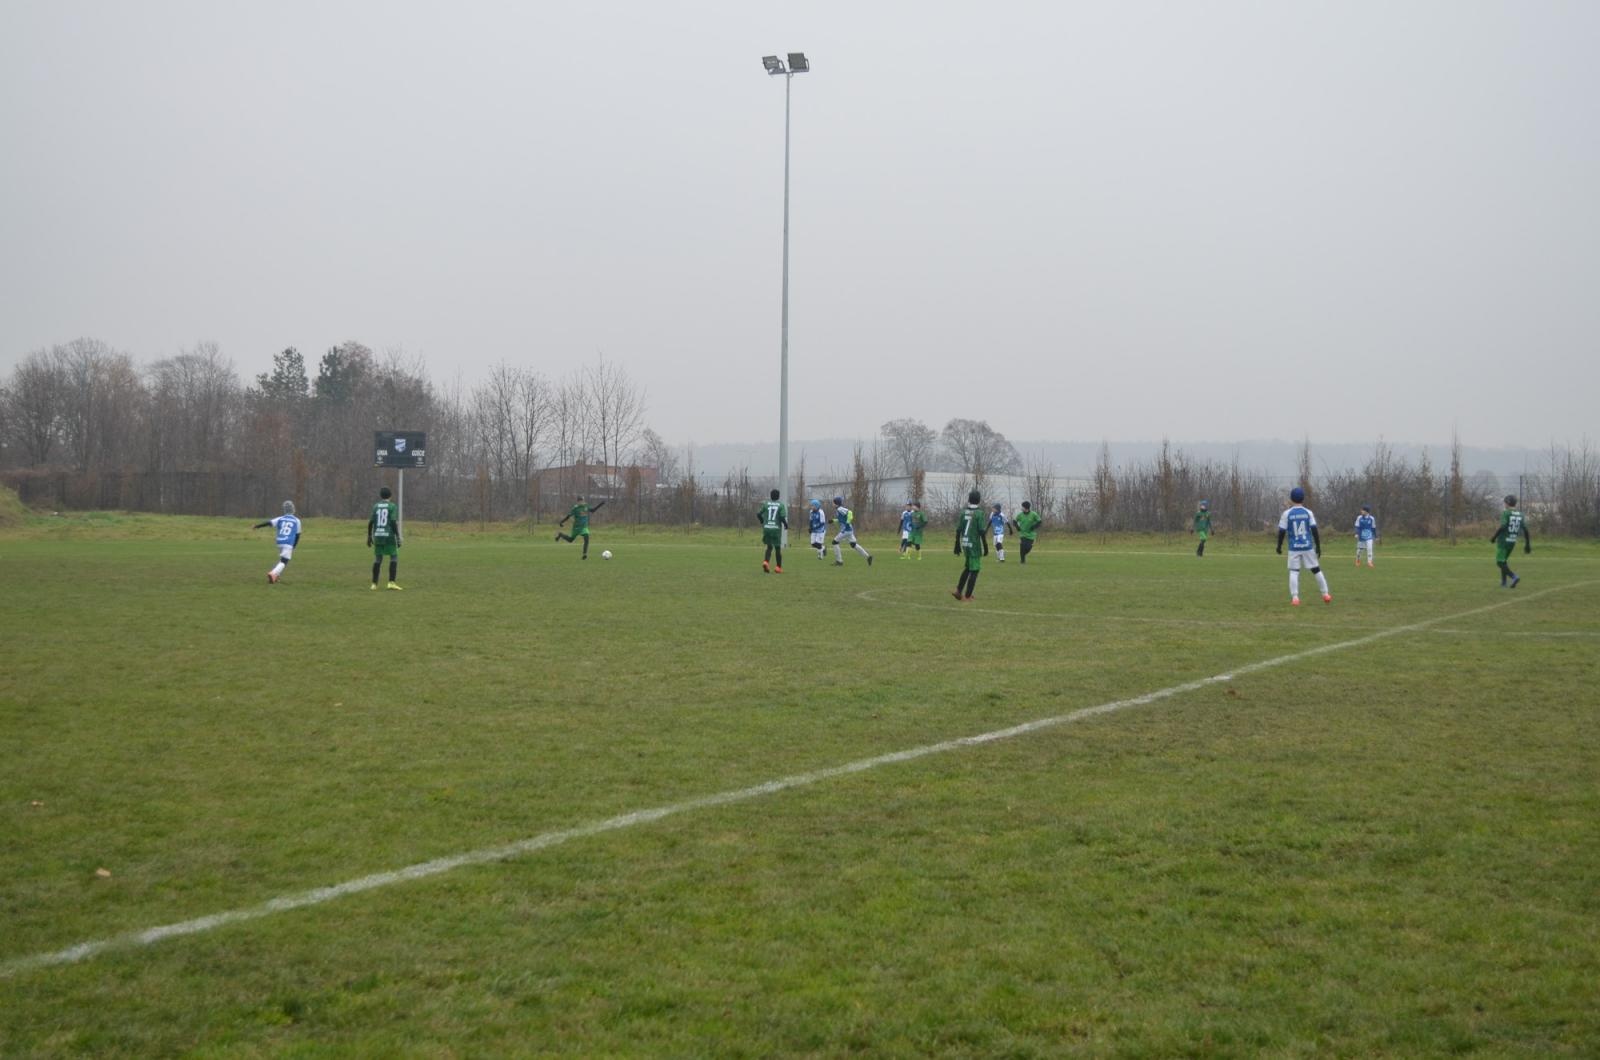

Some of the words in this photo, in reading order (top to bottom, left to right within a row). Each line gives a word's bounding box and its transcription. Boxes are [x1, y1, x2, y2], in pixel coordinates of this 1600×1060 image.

[375, 508, 389, 527] 18
[767, 505, 779, 521] 17
[279, 520, 294, 536] 16
[964, 515, 972, 536] 7
[1292, 520, 1307, 540] 14
